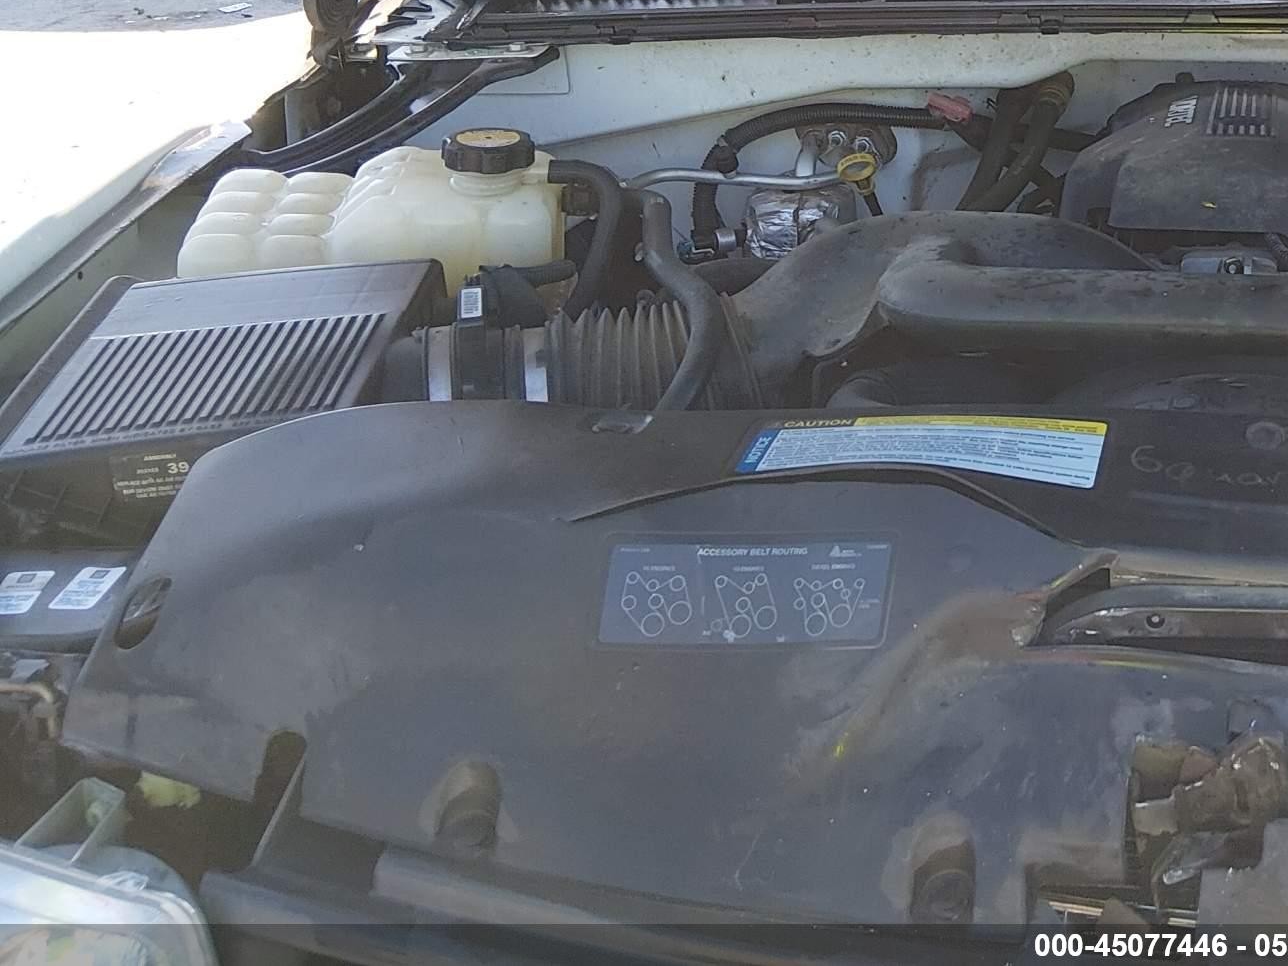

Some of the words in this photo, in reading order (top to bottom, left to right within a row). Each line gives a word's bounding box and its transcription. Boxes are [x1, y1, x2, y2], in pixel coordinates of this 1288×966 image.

[783, 418, 852, 428] CAUTION
[743, 436, 772, 464] NOTICE
[167, 462, 190, 474] 39
[697, 547, 748, 556] ACCESSORY
[750, 546, 771, 556] BELT
[771, 546, 809, 555] ROUTING
